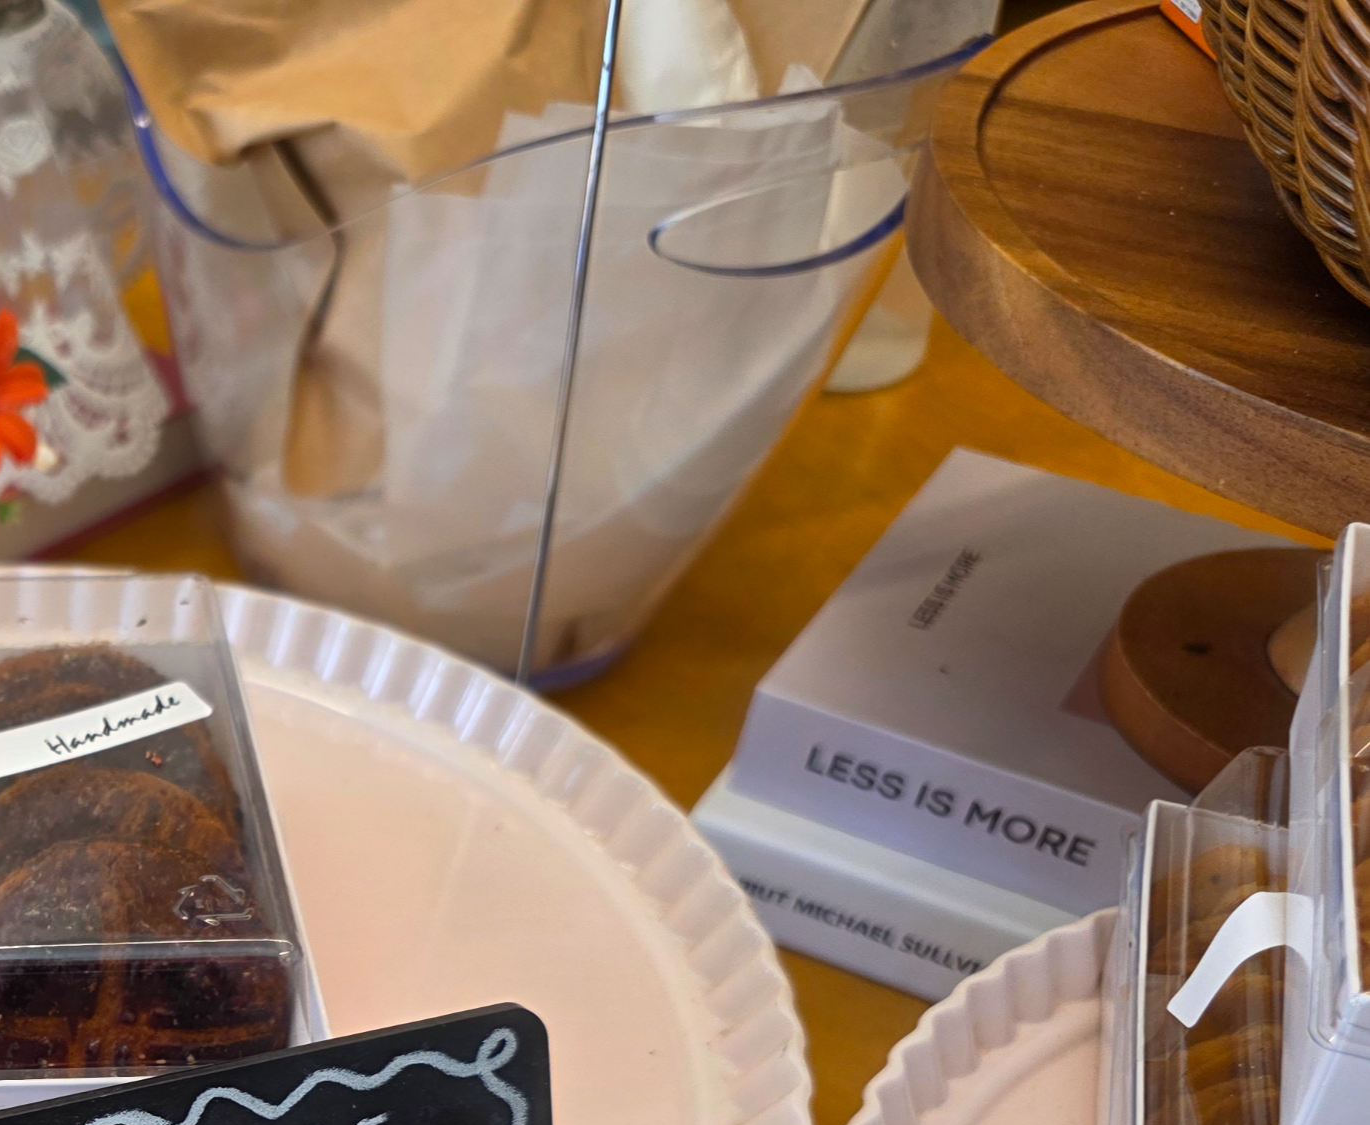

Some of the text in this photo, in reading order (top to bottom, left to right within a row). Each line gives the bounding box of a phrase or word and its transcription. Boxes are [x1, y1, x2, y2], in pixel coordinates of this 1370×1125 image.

[44, 695, 181, 755] Handmade
[804, 744, 1098, 868] LESS IS MORE
[792, 898, 895, 948] MICHAEL
